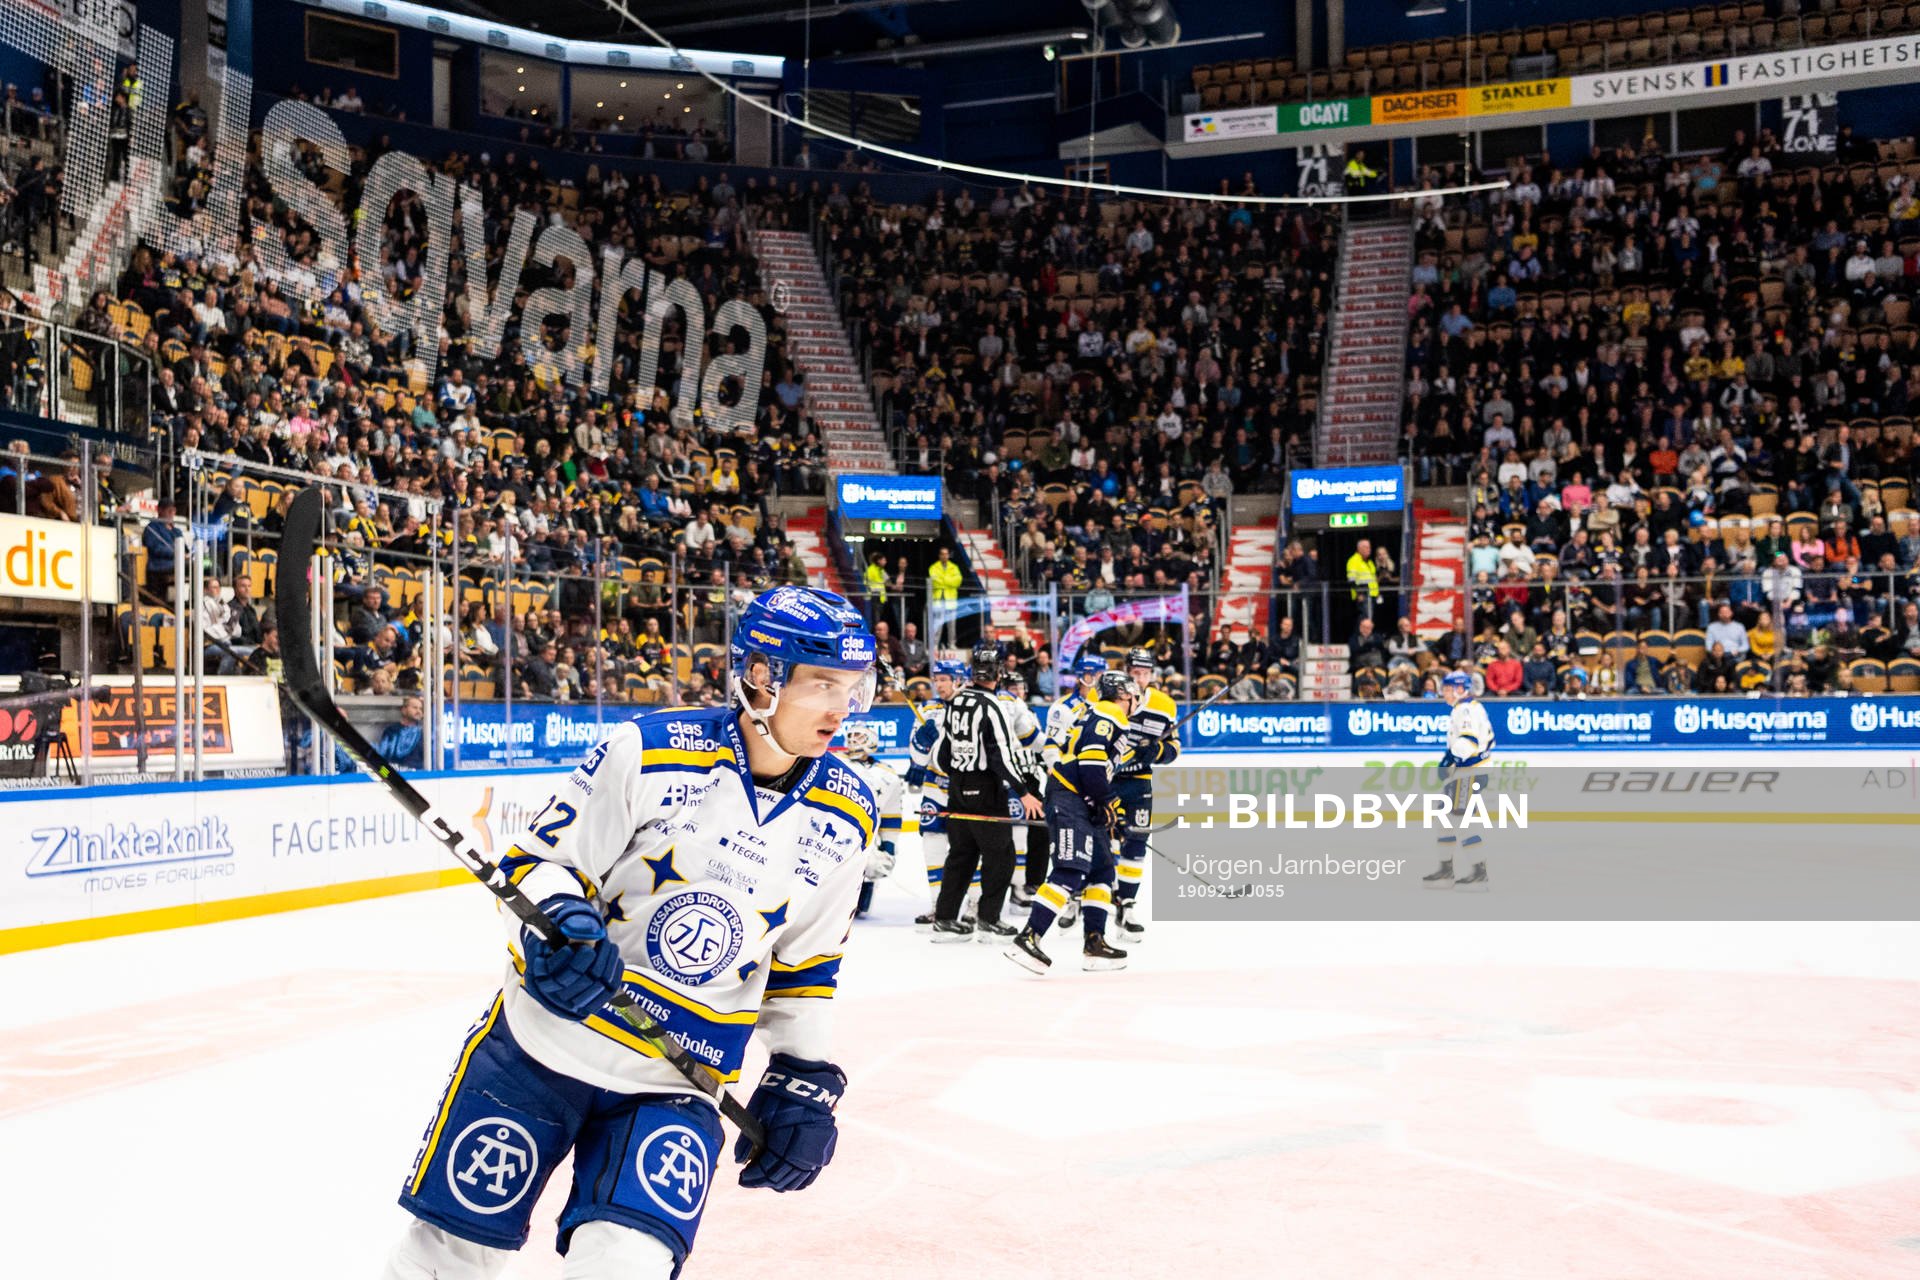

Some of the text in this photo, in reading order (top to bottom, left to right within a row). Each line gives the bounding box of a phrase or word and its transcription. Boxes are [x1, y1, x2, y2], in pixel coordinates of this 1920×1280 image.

[1482, 83, 1558, 102] STANLEY
[1593, 70, 1697, 98] SVENSK
[1300, 103, 1349, 126] OCAY!
[1382, 93, 1457, 113] DACHSER
[859, 486, 936, 504] Husqvarna
[1315, 478, 1398, 497] Husqvarna
[6, 530, 74, 590] dic
[841, 636, 865, 650] clas
[841, 649, 873, 661] ohlson
[89, 697, 217, 718] WORK
[666, 721, 703, 736] clas
[952, 710, 969, 736] 64
[1220, 713, 1331, 736] Husqvarna
[1372, 711, 1450, 735] Husqva
[1532, 710, 1652, 734] Husqvarna
[1701, 708, 1827, 732] Husqvarna
[669, 735, 721, 752] ohlson
[729, 731, 747, 775] TEGERA
[801, 759, 821, 792] TEGERA
[828, 767, 861, 790] clas
[1155, 766, 1324, 799] SUBWAY
[756, 791, 777, 803] SHL
[826, 780, 873, 815] ohlson
[25, 815, 235, 878] Zinkteknik
[731, 842, 766, 865] TEGERA
[84, 862, 237, 894] MOVES FORWARD
[647, 893, 695, 943] LEKSANDS
[650, 954, 703, 986] ISHOCKEY
[760, 1071, 838, 1108] CCM
